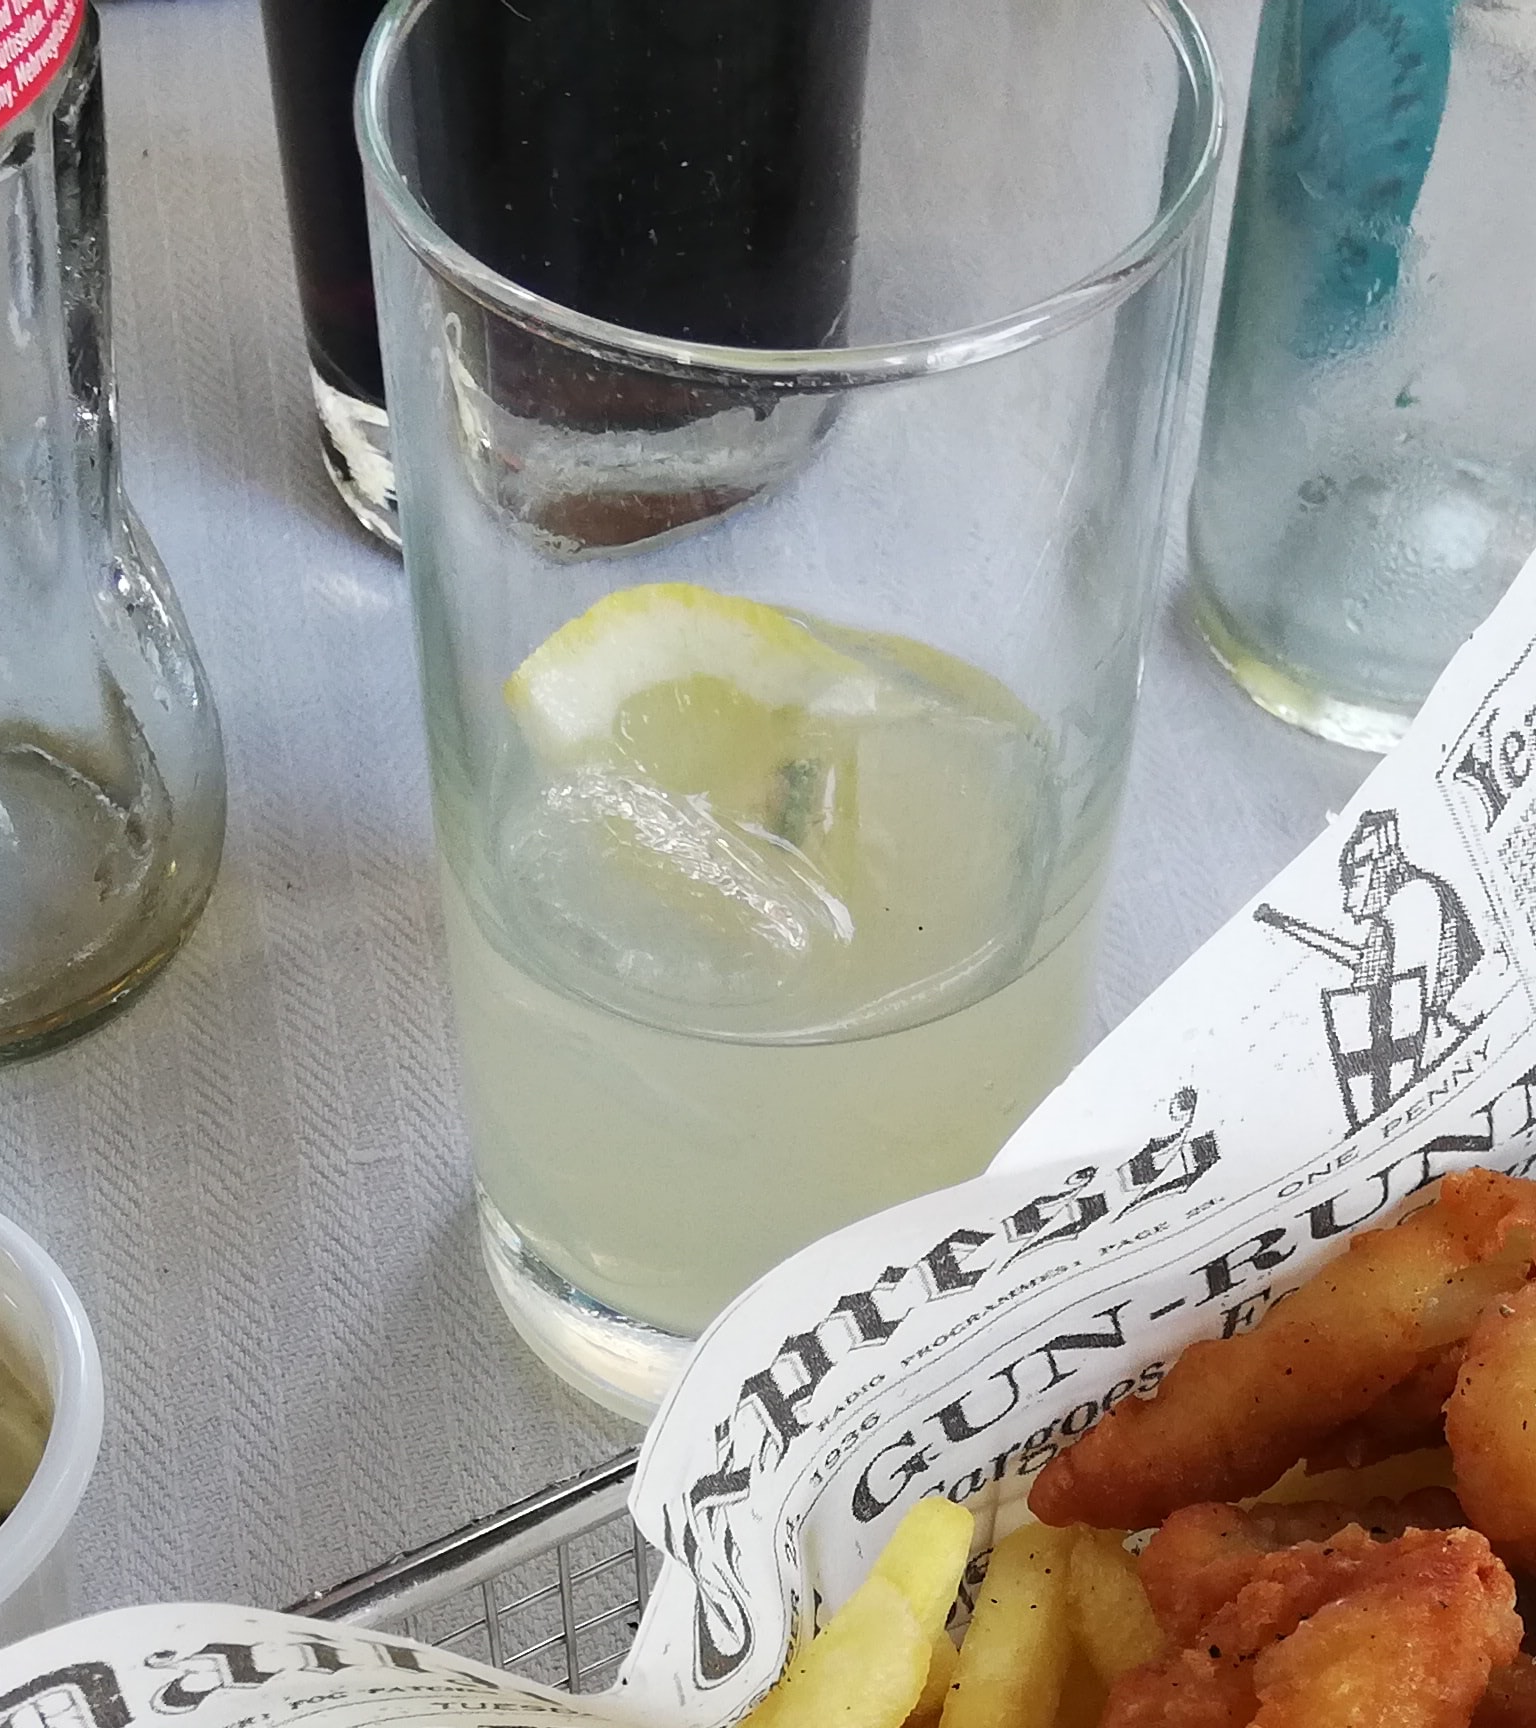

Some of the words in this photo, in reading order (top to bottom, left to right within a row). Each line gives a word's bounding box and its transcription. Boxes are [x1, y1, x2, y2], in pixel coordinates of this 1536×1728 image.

[815, 1374, 886, 1434] RADIO
[1098, 1220, 1170, 1254] PAGE
[1278, 1143, 1359, 1199] ONE
[1381, 1036, 1491, 1141] PENNY
[810, 1411, 881, 1489] 1936
